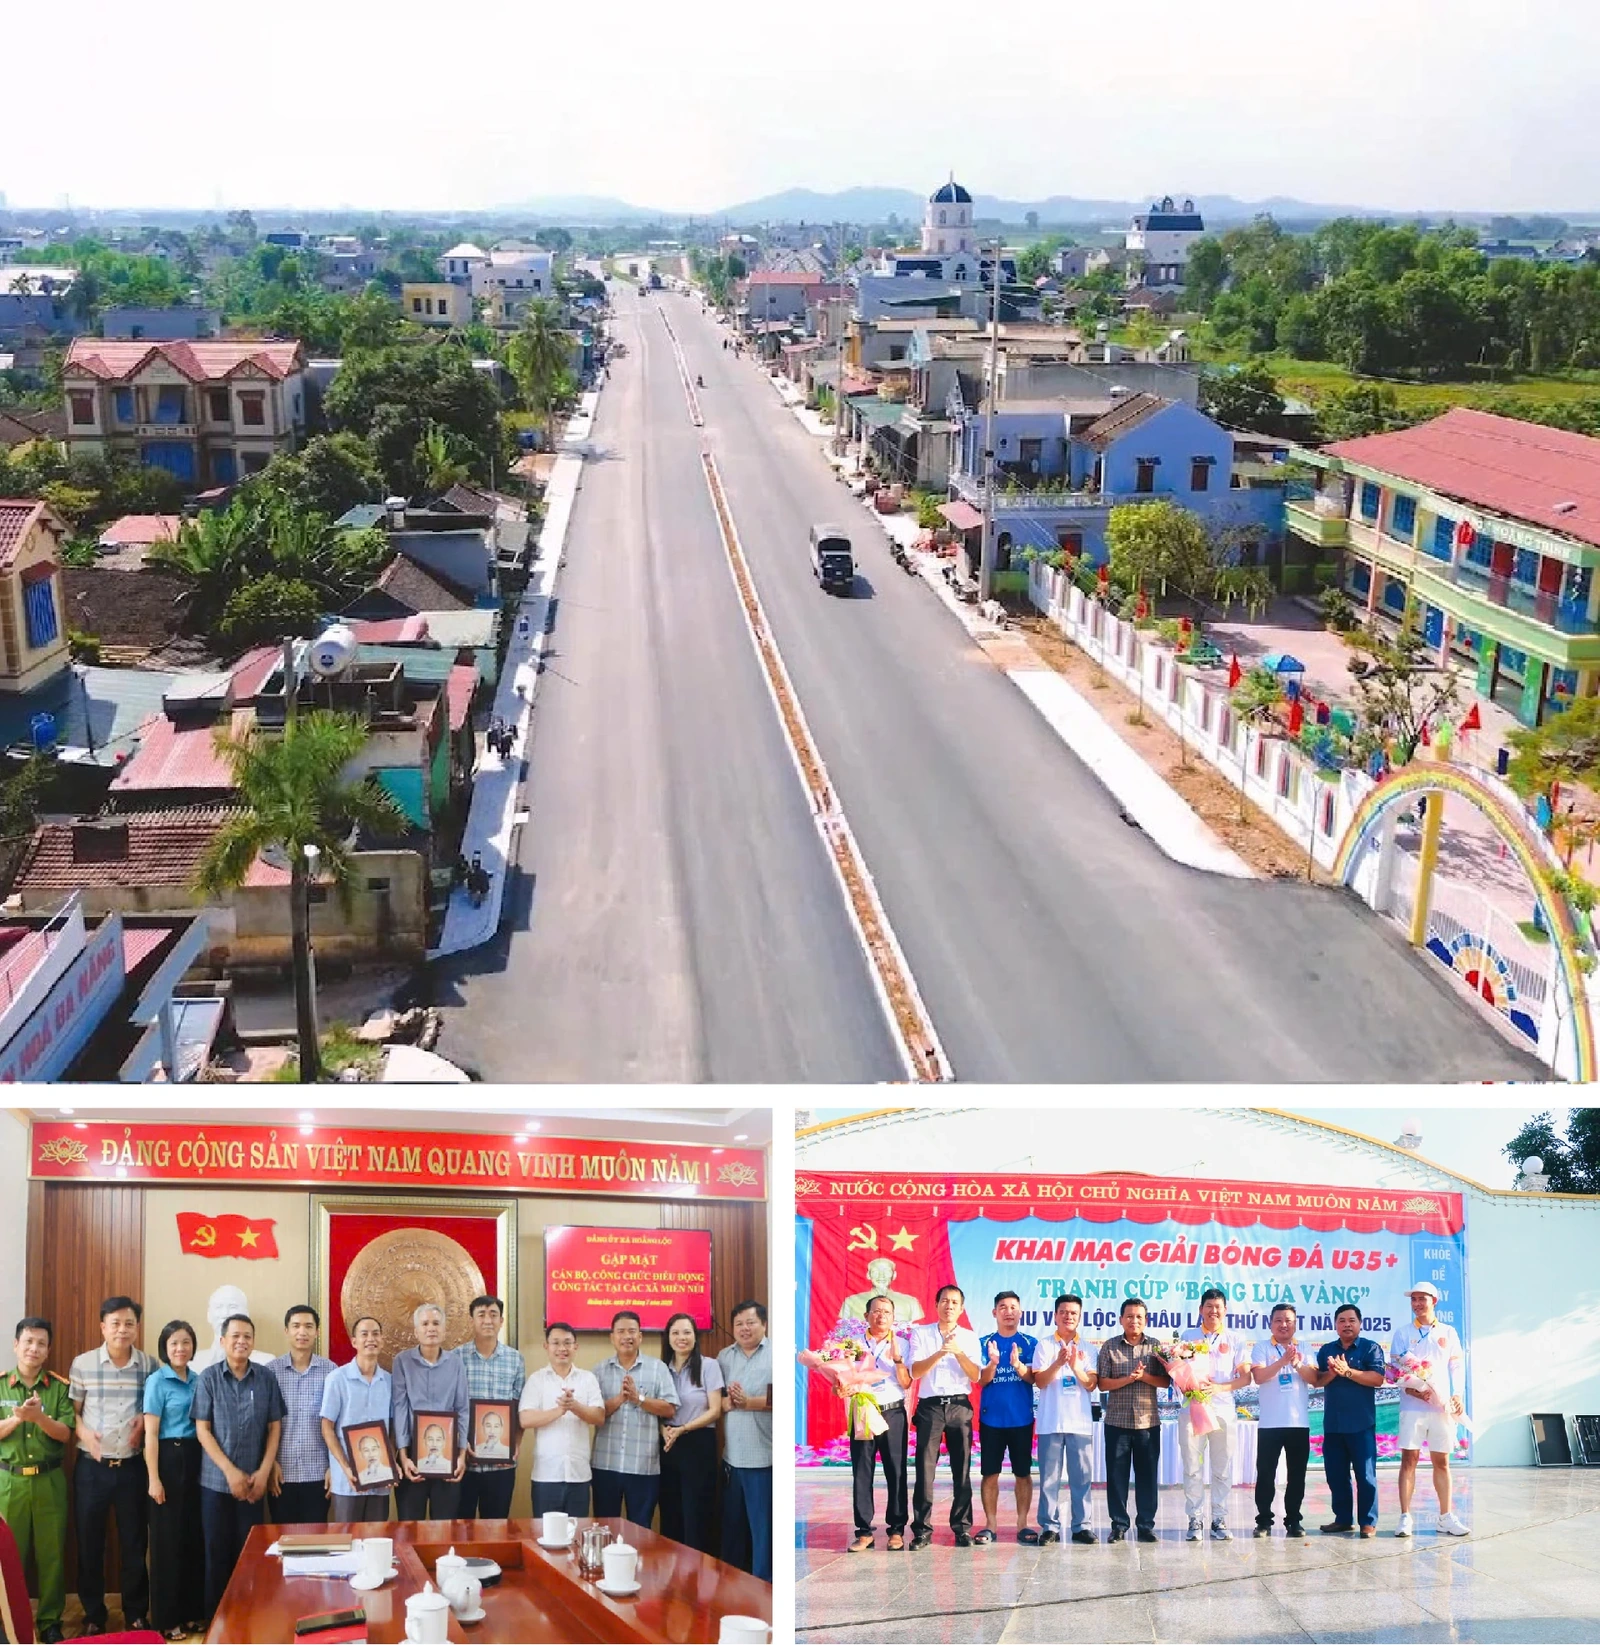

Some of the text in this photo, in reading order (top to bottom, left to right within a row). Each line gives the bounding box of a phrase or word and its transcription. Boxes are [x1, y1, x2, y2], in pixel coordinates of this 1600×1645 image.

[101, 1127, 171, 1167] ĐẢNG
[178, 1132, 245, 1175] CỘNG
[250, 1131, 299, 1169] SẢN
[306, 1137, 362, 1176] VIỆT
[367, 1146, 422, 1172] NAM
[427, 1147, 511, 1177] QUANG
[517, 1151, 576, 1179] VINH
[580, 1148, 646, 1182] MUÔN
[830, 1180, 1398, 1212] NƯỚC CỘNG HÒA XÃ HỘI CHỦ NGHĨA VIỆT NAM MUÔN NĂM
[994, 1235, 1399, 1271] KHAI MẠC GIẢI BÓNG ĐÁ U35+
[1424, 1245, 1451, 1260] KHỎE
[552, 1268, 572, 1279] CÁN
[593, 1270, 620, 1280] CÔNG
[623, 1270, 651, 1281] CHỨC
[1432, 1265, 1446, 1281] ĐỂ
[552, 1281, 581, 1292] CÔNG
[583, 1281, 604, 1292] TÁC
[605, 1283, 621, 1294] TẠI
[623, 1282, 644, 1293] CÁC
[646, 1282, 658, 1293] XÃ
[688, 1283, 704, 1294] NÚI
[1036, 1278, 1118, 1300] TRANH
[1123, 1274, 1169, 1300] CÚP
[1252, 1278, 1296, 1303] LÚA
[1300, 1279, 1371, 1305] VÀNG”
[1438, 1288, 1450, 1301] ÂY
[1083, 1308, 1116, 1330] LỘC
[1147, 1309, 1181, 1328] HÂU
[1226, 1310, 1259, 1329] THỨ
[1262, 1314, 1305, 1330] NT
[1311, 1312, 1336, 1331] NĂ
[1360, 1317, 1392, 1332] 025
